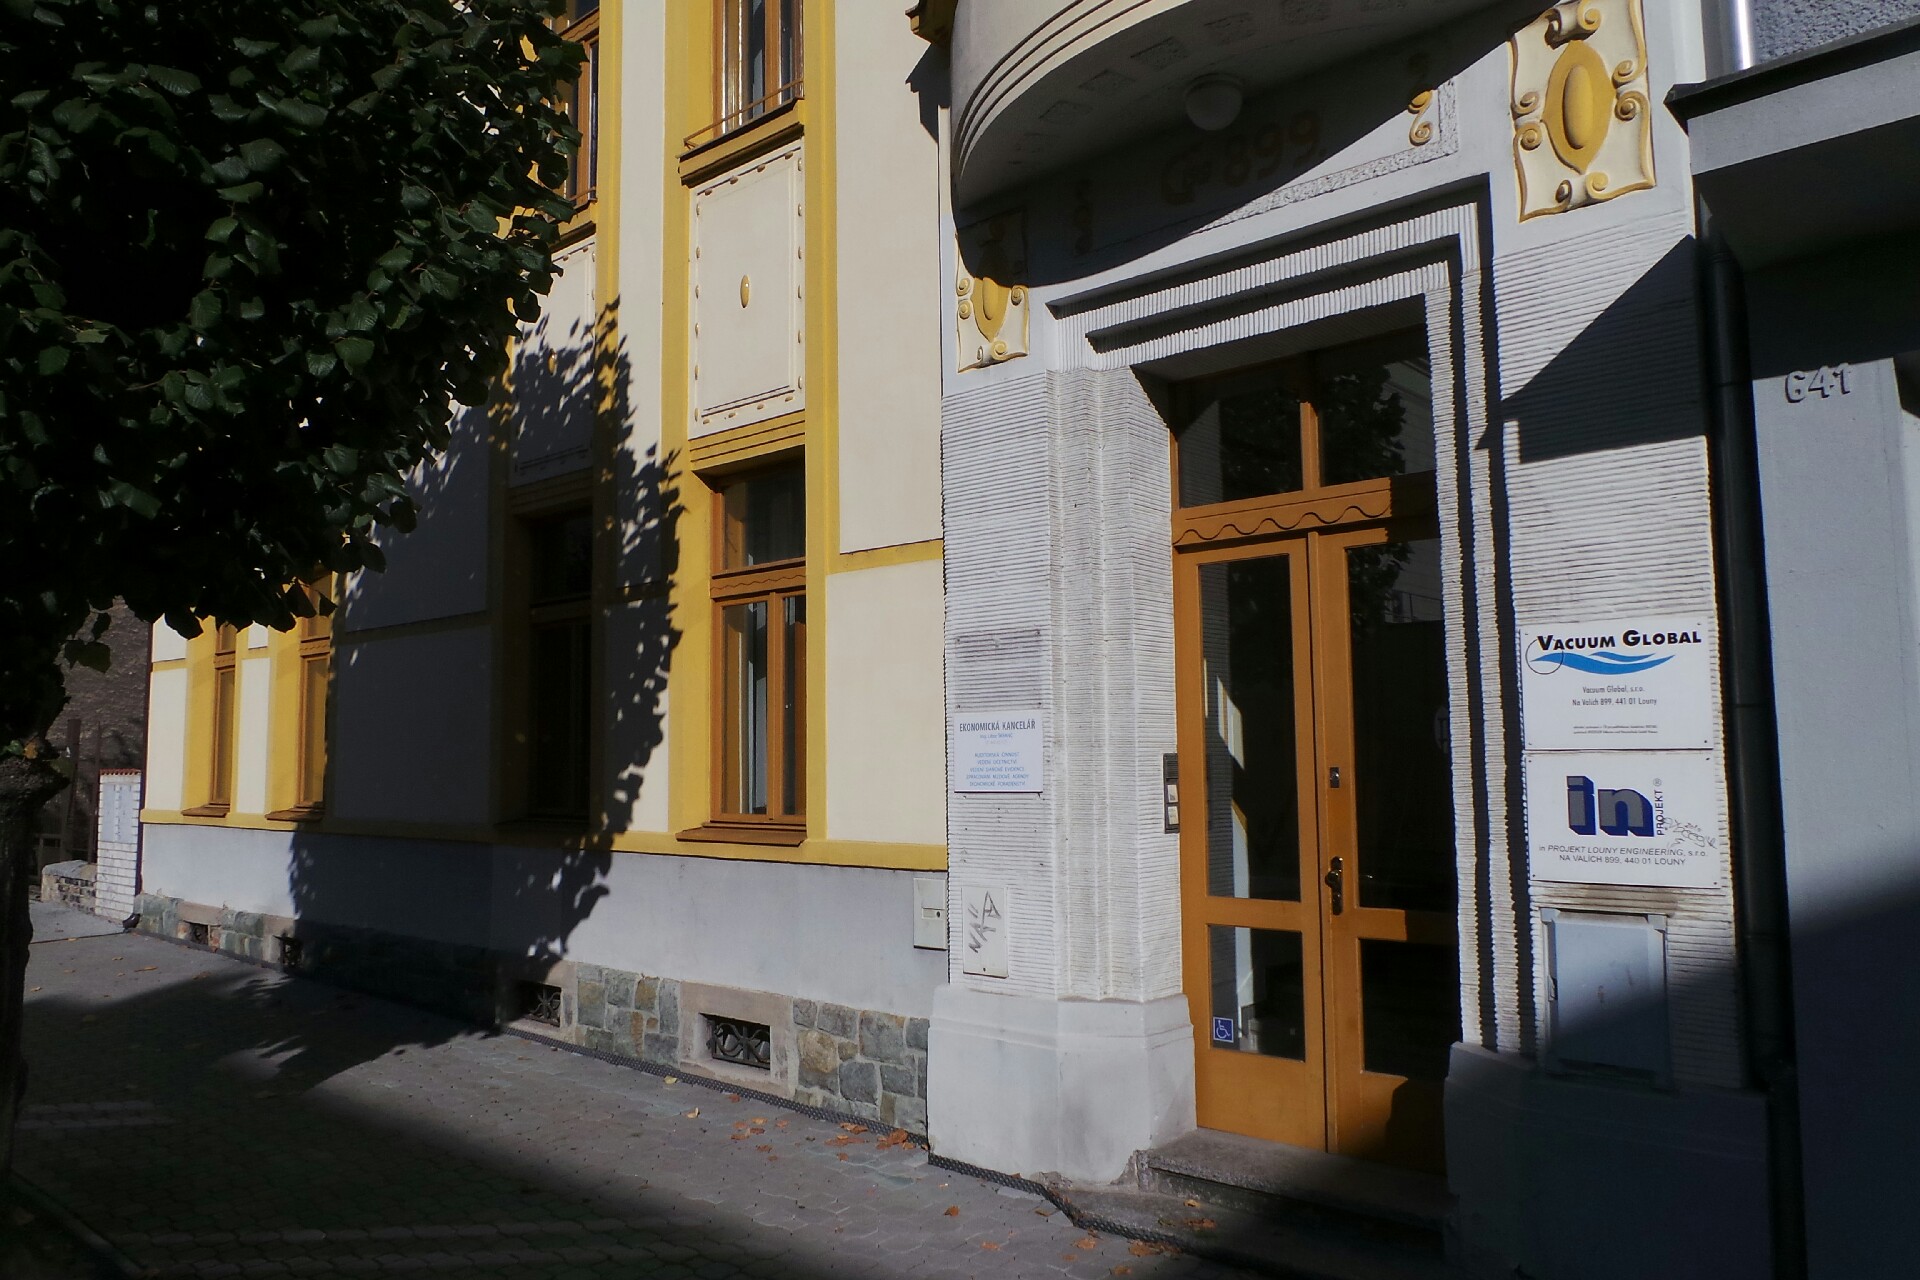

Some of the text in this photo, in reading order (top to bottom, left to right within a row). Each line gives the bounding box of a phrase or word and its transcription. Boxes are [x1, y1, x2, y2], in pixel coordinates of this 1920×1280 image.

[1785, 362, 1851, 403] 641
[1537, 629, 1702, 651] VACUUM GLOBAL
[1582, 686, 1605, 694] Vacuum
[1628, 697, 1636, 705] 01
[1638, 697, 1657, 706] Louny
[960, 718, 1036, 732] EKONOMICKÁ KANCELÁŘ
[1566, 775, 1655, 837] in
[1654, 789, 1666, 836] PROJEKT
[1548, 845, 1586, 854] PROJEKT
[1587, 846, 1617, 855] LOUNY
[1654, 858, 1686, 866] LOUNY
